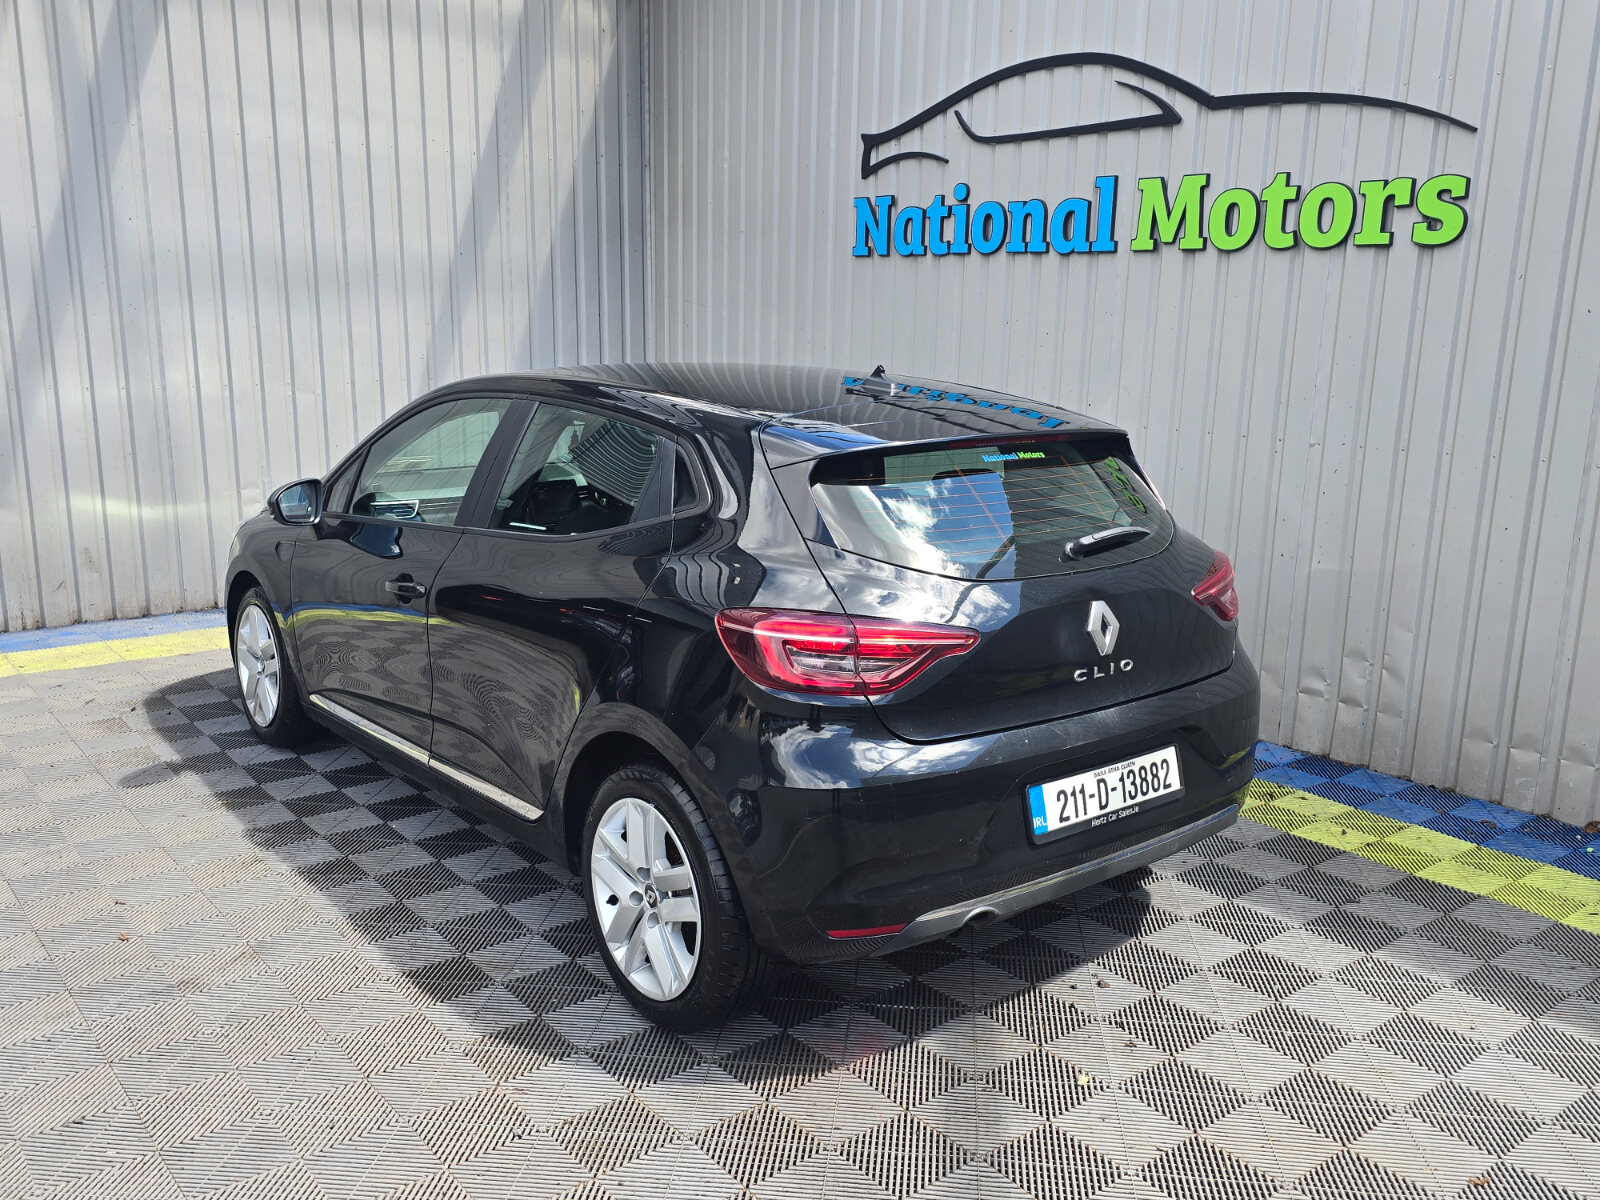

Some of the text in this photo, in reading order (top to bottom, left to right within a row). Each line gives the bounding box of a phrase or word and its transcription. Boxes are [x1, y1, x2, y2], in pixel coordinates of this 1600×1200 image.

[852, 172, 1471, 256] National Motors
[981, 451, 1046, 463] National Motors
[1074, 659, 1134, 682] CLIO
[1056, 758, 1172, 824] 211-D-13882
[1033, 816, 1048, 829] IRL
[1091, 816, 1107, 828] Hertz
[1108, 812, 1118, 822] Car
